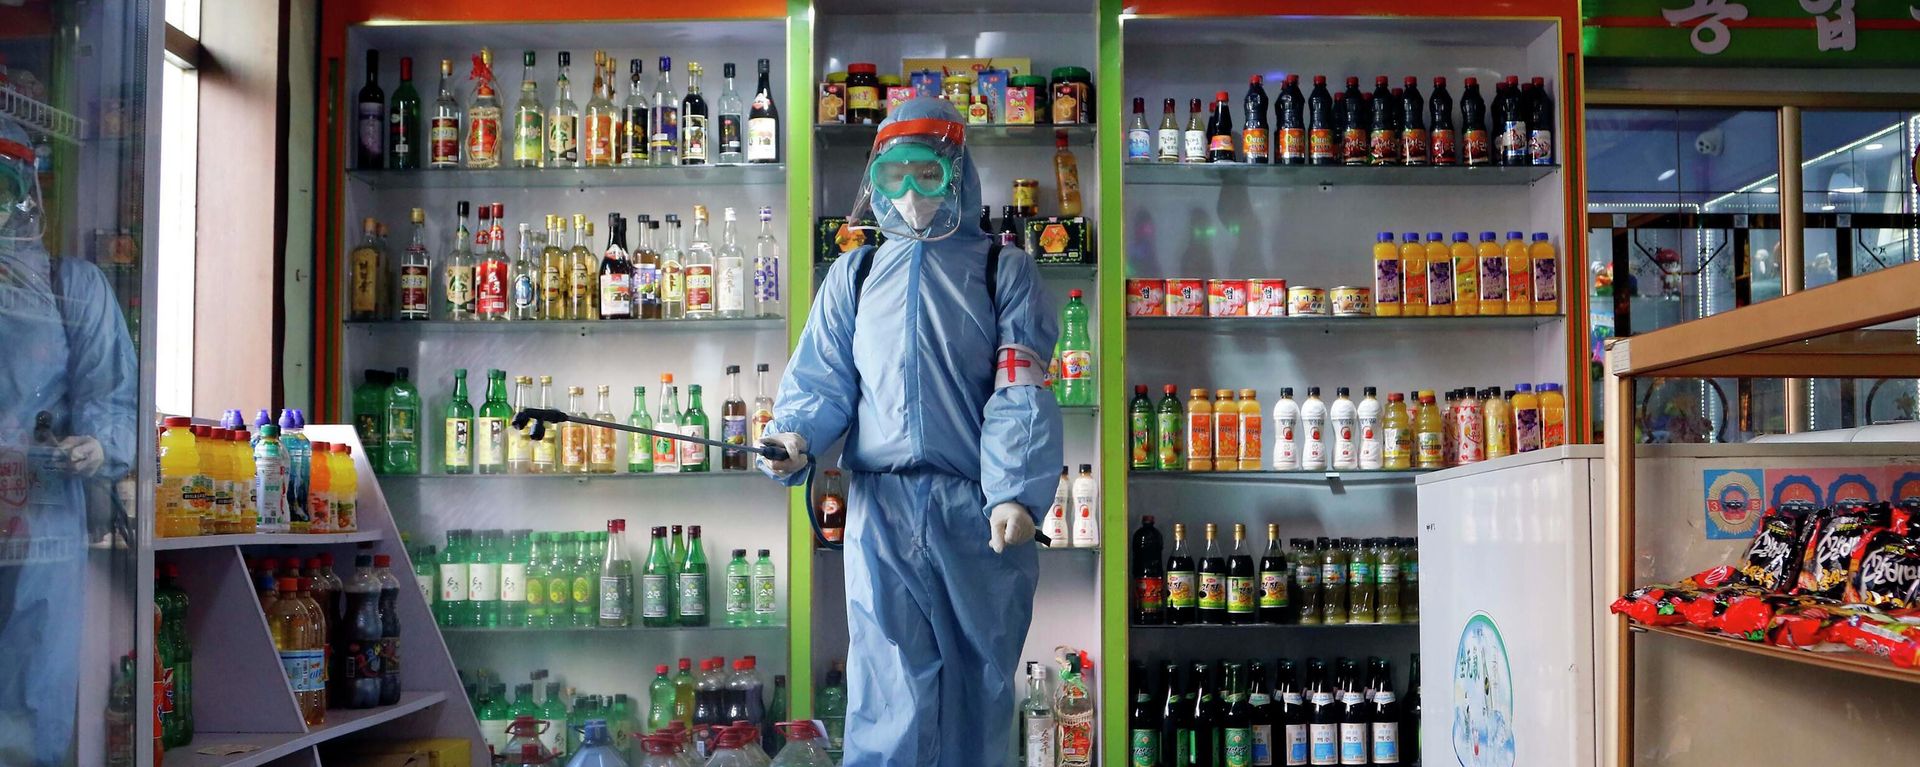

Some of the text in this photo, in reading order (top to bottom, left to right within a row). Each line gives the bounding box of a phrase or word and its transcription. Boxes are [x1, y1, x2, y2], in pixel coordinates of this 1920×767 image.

[605, 592, 619, 600] 소주
[646, 591, 661, 600] 소주
[684, 589, 698, 598] 소주
[733, 588, 746, 596] 소주
[760, 588, 774, 596] 소주
